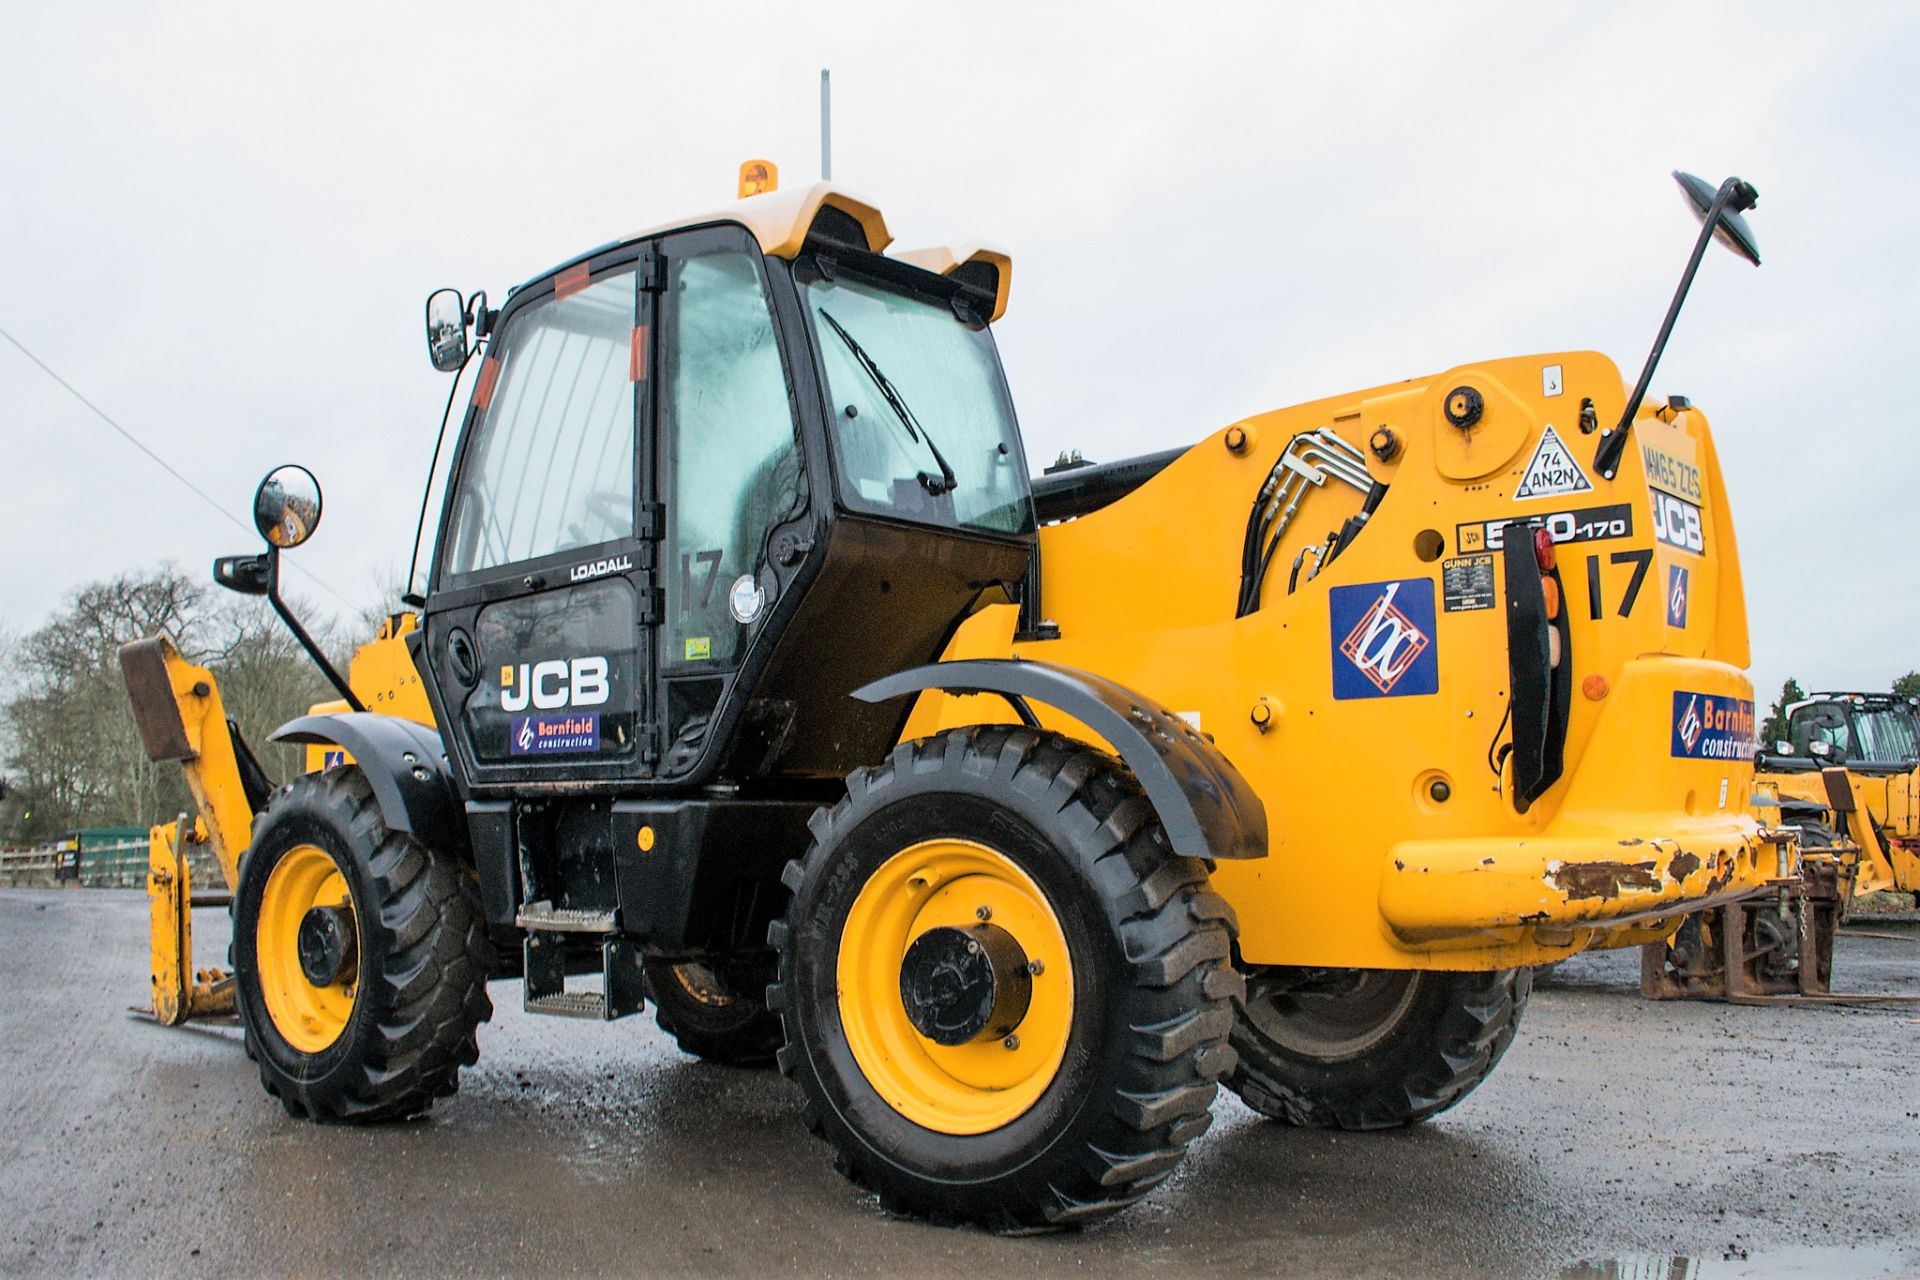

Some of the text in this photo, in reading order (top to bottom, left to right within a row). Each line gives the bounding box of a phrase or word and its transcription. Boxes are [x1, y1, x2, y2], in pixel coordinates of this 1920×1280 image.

[1541, 451, 1561, 469] 74
[1532, 468, 1574, 488] AN2N
[1486, 513, 1626, 549] 50-170
[1653, 493, 1703, 551] JCB
[570, 556, 632, 581] LOADALL
[1444, 556, 1492, 569] GUNN JCB
[681, 549, 723, 613] 17
[1587, 549, 1653, 620] 17
[501, 656, 610, 712] JCB
[538, 718, 593, 736] Barnfield
[1704, 699, 1754, 735] Barnfiel
[538, 735, 593, 749] construction
